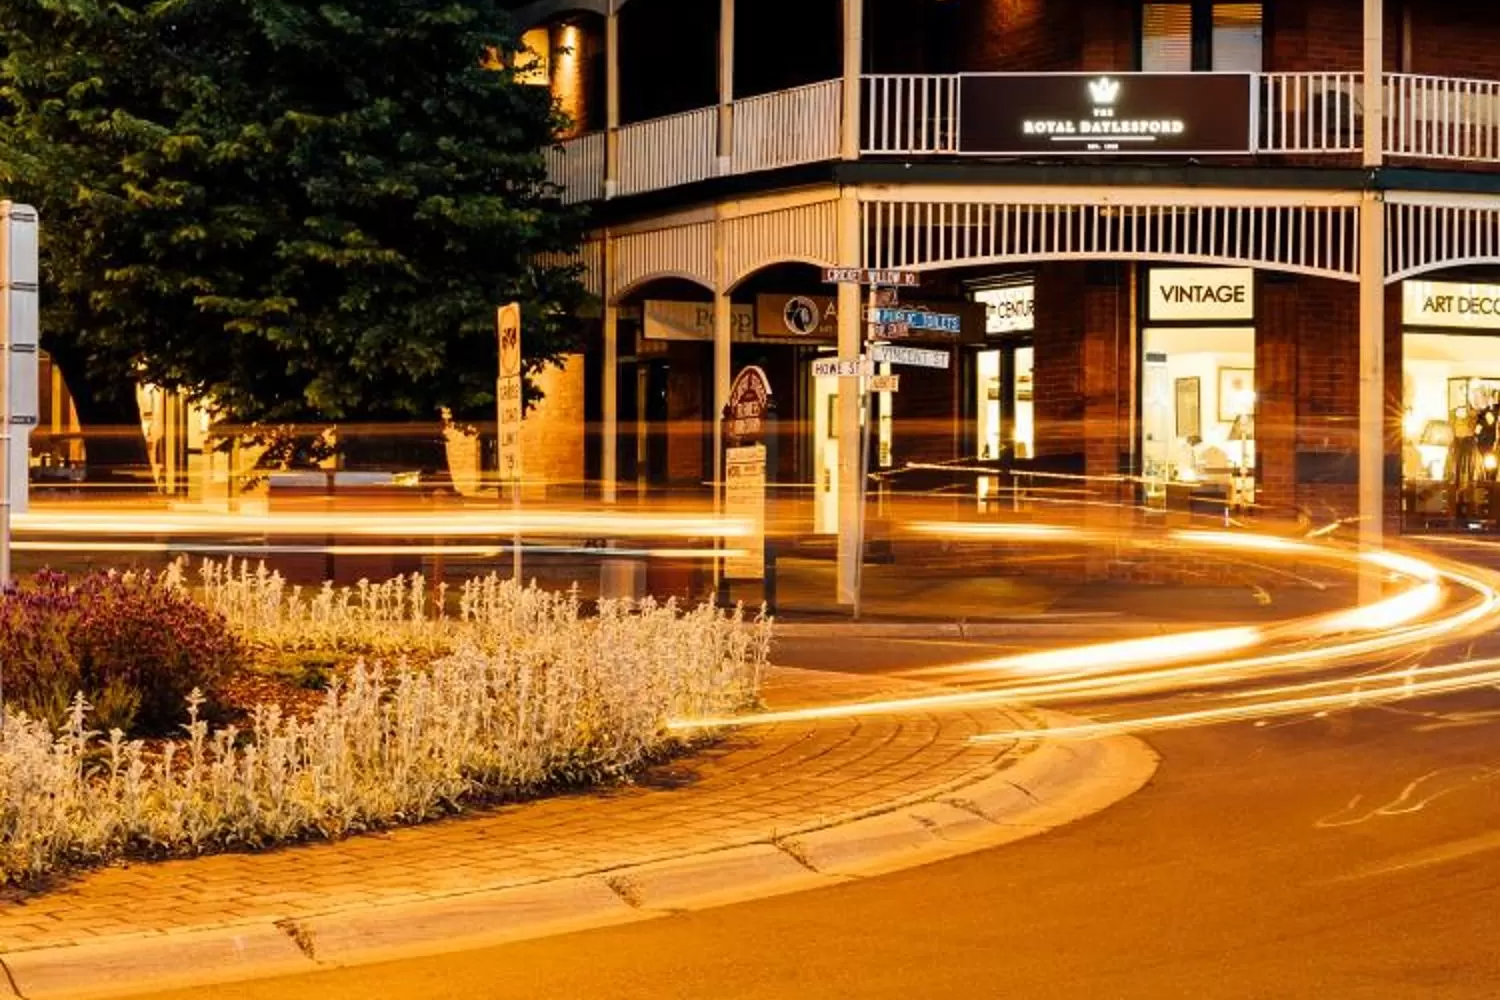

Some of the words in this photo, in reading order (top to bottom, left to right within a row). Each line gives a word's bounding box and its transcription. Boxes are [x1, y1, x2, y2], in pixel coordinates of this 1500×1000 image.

[1023, 120, 1076, 134] ROYAL
[1080, 120, 1185, 134] DAYLESFORD
[1160, 285, 1246, 303] VINTAGE
[1422, 296, 1453, 313] ART
[881, 347, 928, 365] VINCENT
[932, 353, 950, 366] ST
[815, 363, 843, 375] HOWE
